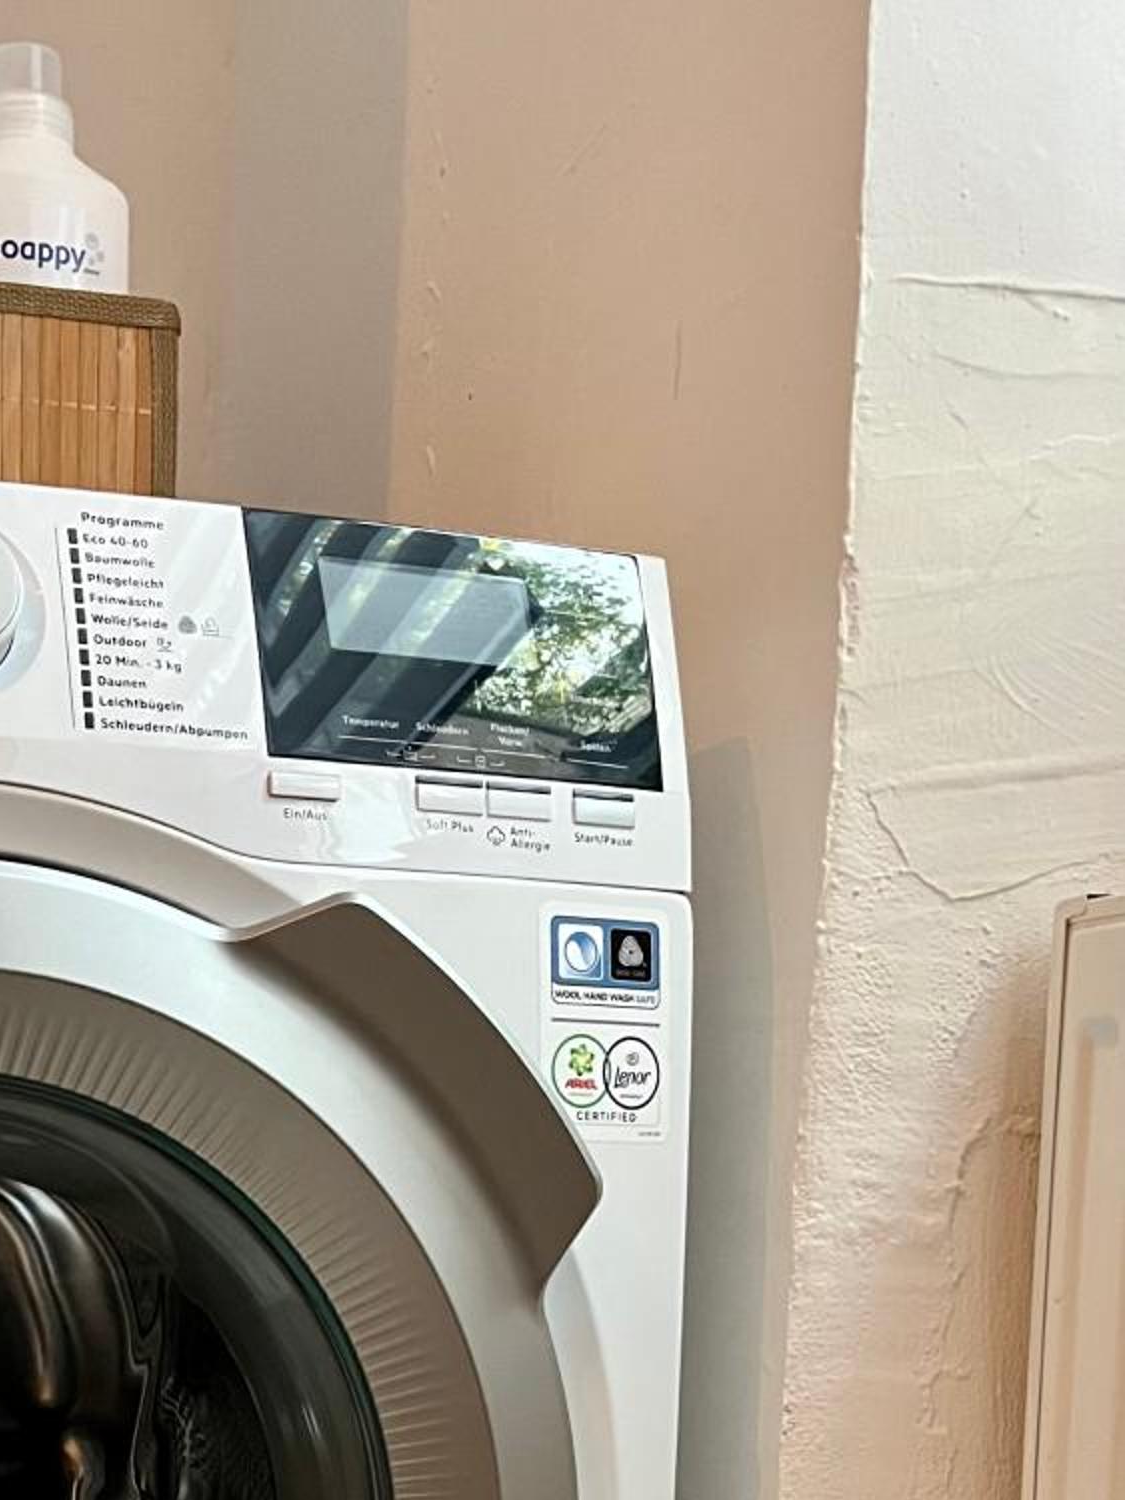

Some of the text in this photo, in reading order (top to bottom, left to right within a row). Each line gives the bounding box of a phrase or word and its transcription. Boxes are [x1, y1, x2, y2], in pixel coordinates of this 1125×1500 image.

[80, 511, 165, 531] Programme
[82, 533, 149, 549] Eco 40-60
[84, 551, 156, 568] Baumwolle
[86, 572, 164, 589] Pflegeleicht
[89, 591, 164, 609] Feinwäsche
[91, 613, 169, 630] Wolle/Seide
[93, 633, 148, 649] Outdoor
[95, 654, 112, 666] 20
[154, 658, 163, 670] 3
[166, 660, 182, 674] kg
[97, 675, 148, 690] Daunen
[99, 695, 185, 714] Leichtbügeln
[100, 717, 248, 741] Schleudern/Abpumpen
[341, 715, 400, 730] Temperatur
[283, 807, 328, 821] Ein/Aus
[574, 831, 633, 848] Start/Pause
[555, 990, 582, 1000] WOOL
[584, 992, 608, 1001] HAND
[610, 994, 634, 1003] WASH
[565, 1077, 598, 1090] ARIEL
[613, 1067, 652, 1089] Lenor
[576, 1111, 638, 1123] CERTIFIED
